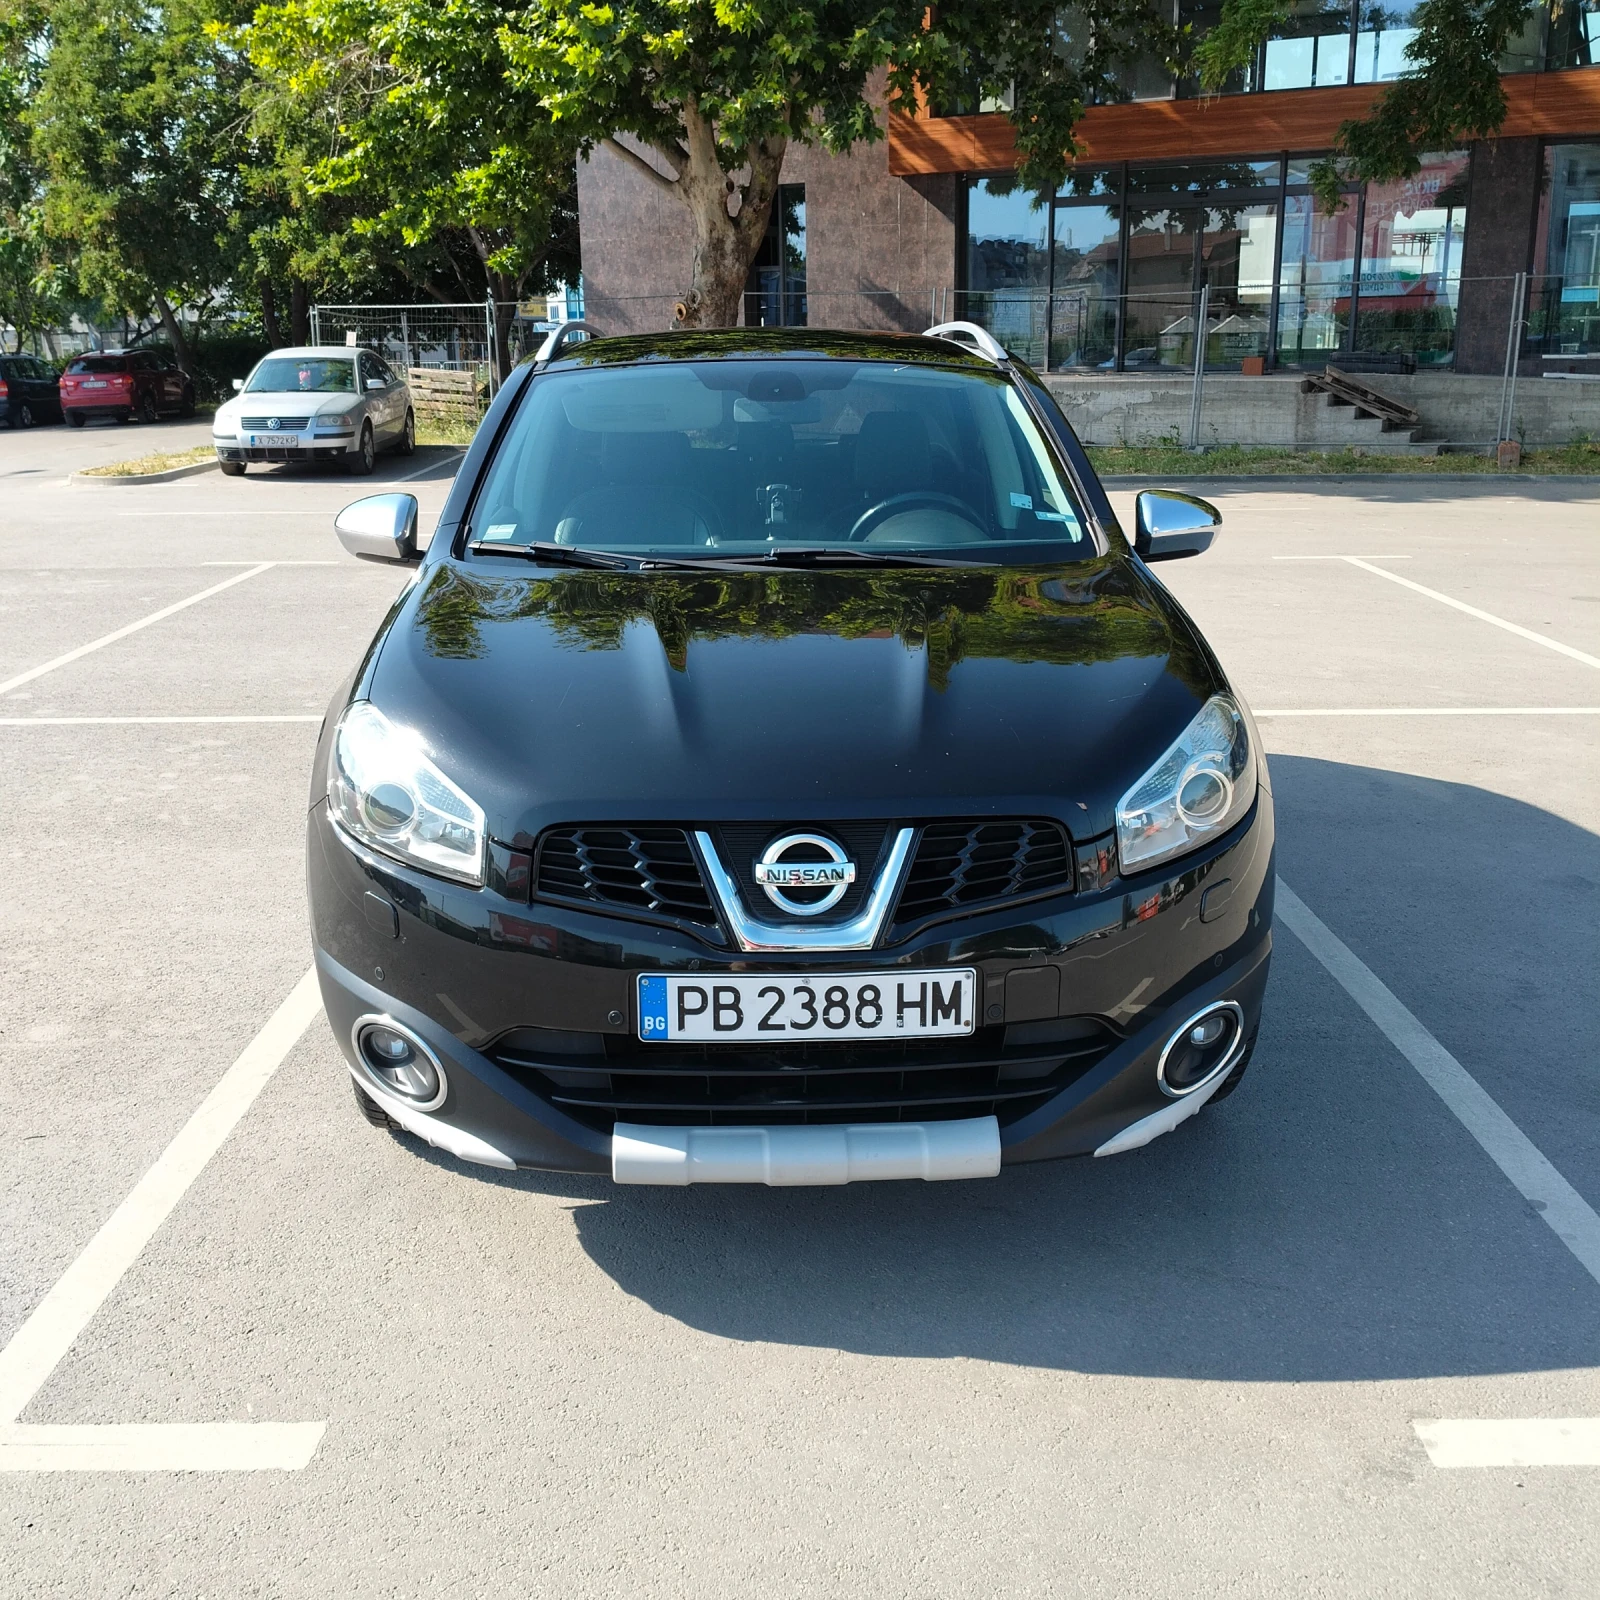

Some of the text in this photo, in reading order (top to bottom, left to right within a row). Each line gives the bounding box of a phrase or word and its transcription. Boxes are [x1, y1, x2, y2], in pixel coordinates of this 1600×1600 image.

[767, 868, 845, 881] NISSAN
[677, 980, 962, 1032] PB 2388 HM
[644, 1016, 666, 1031] BG
